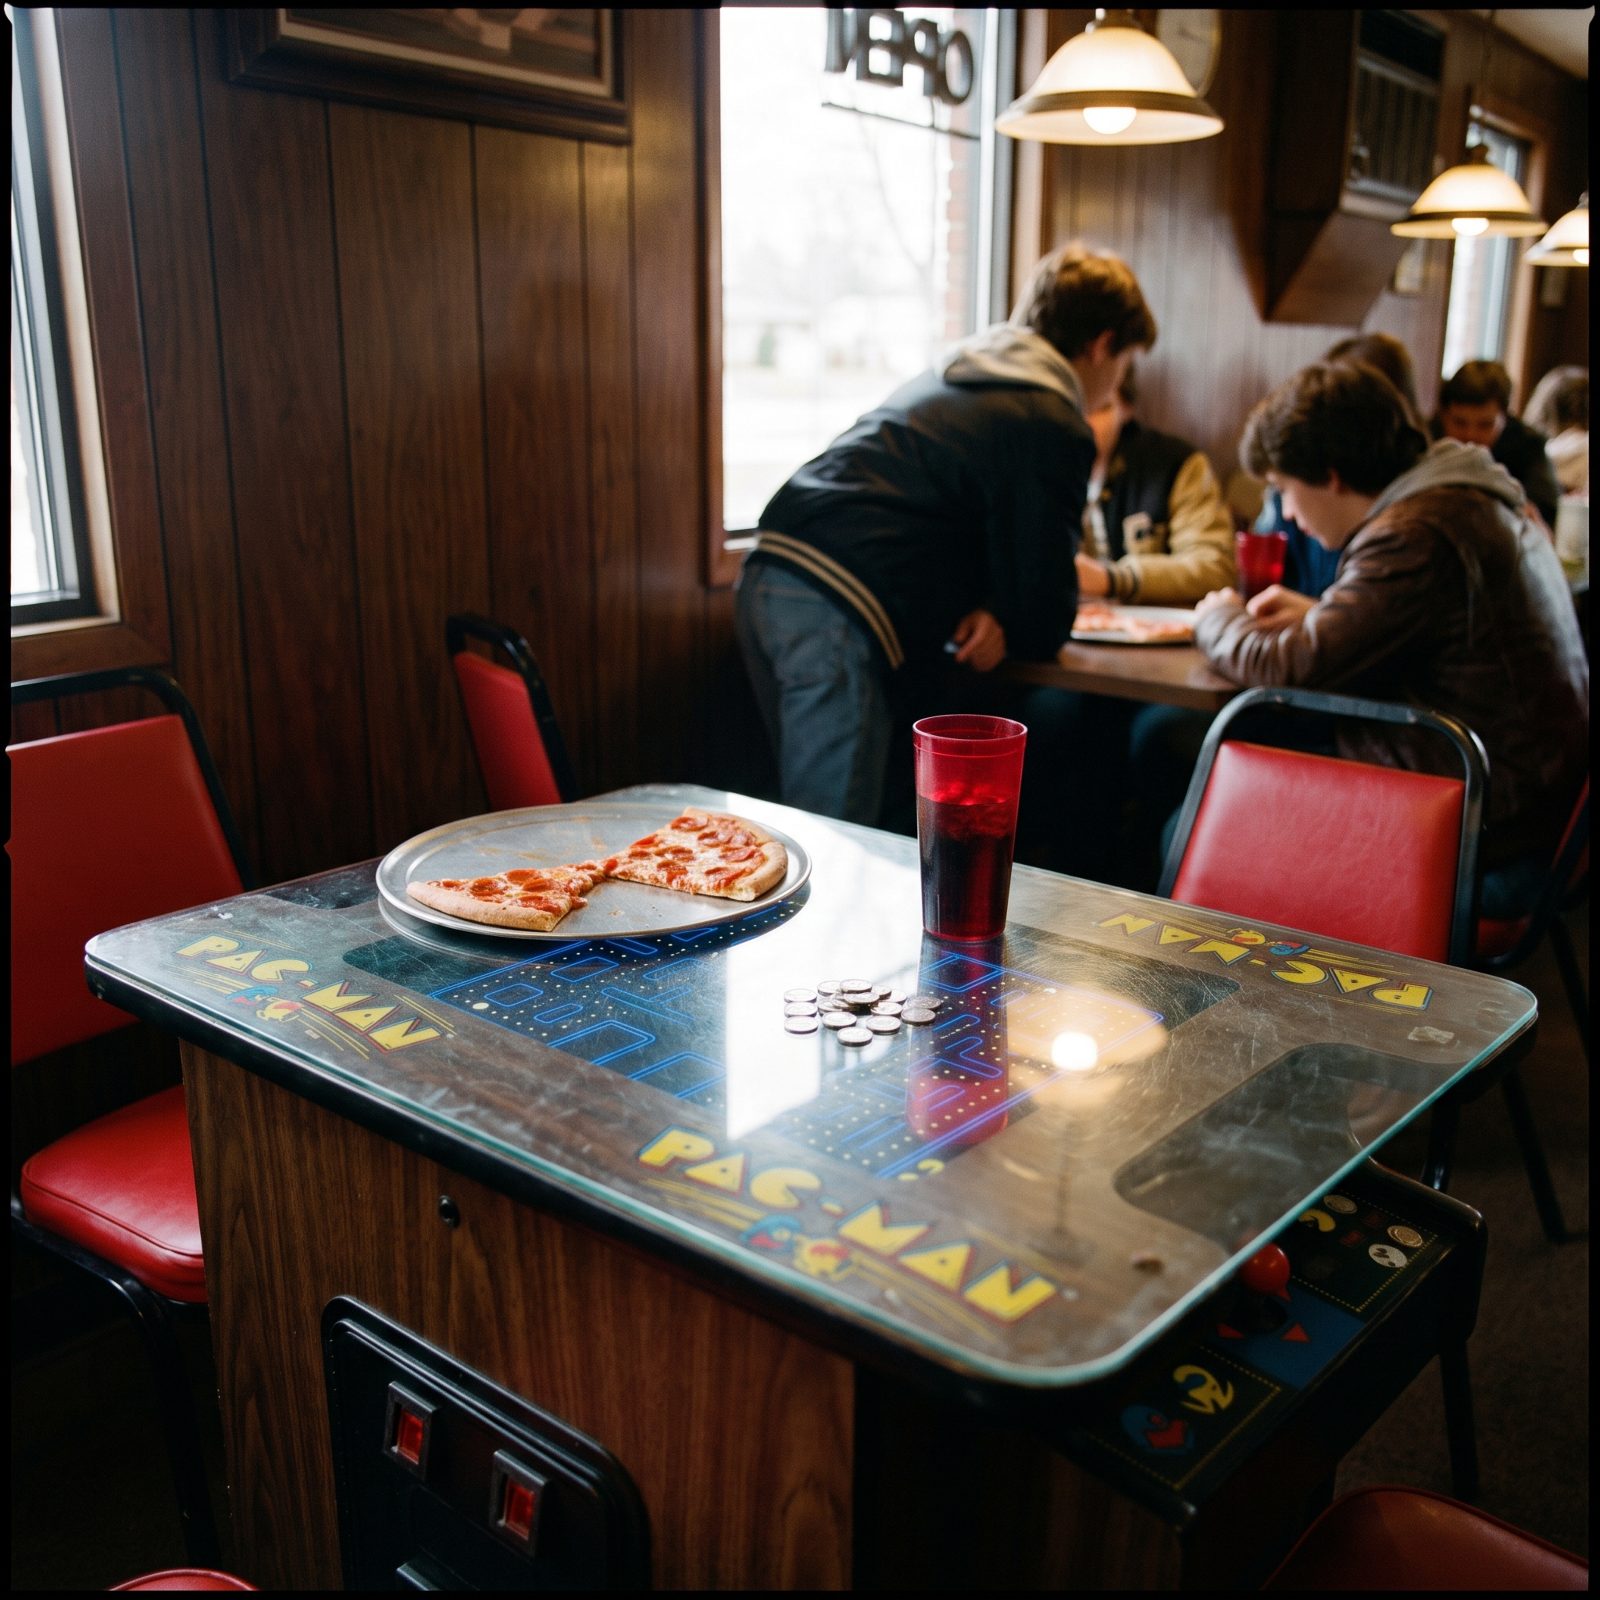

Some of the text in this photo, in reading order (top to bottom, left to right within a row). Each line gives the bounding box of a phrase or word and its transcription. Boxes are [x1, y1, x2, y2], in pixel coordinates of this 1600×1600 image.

[174, 935, 442, 1054] PAC-MAN
[1098, 912, 1434, 1010] PAC-MAN
[638, 1123, 1058, 1326] PAC-MAN
